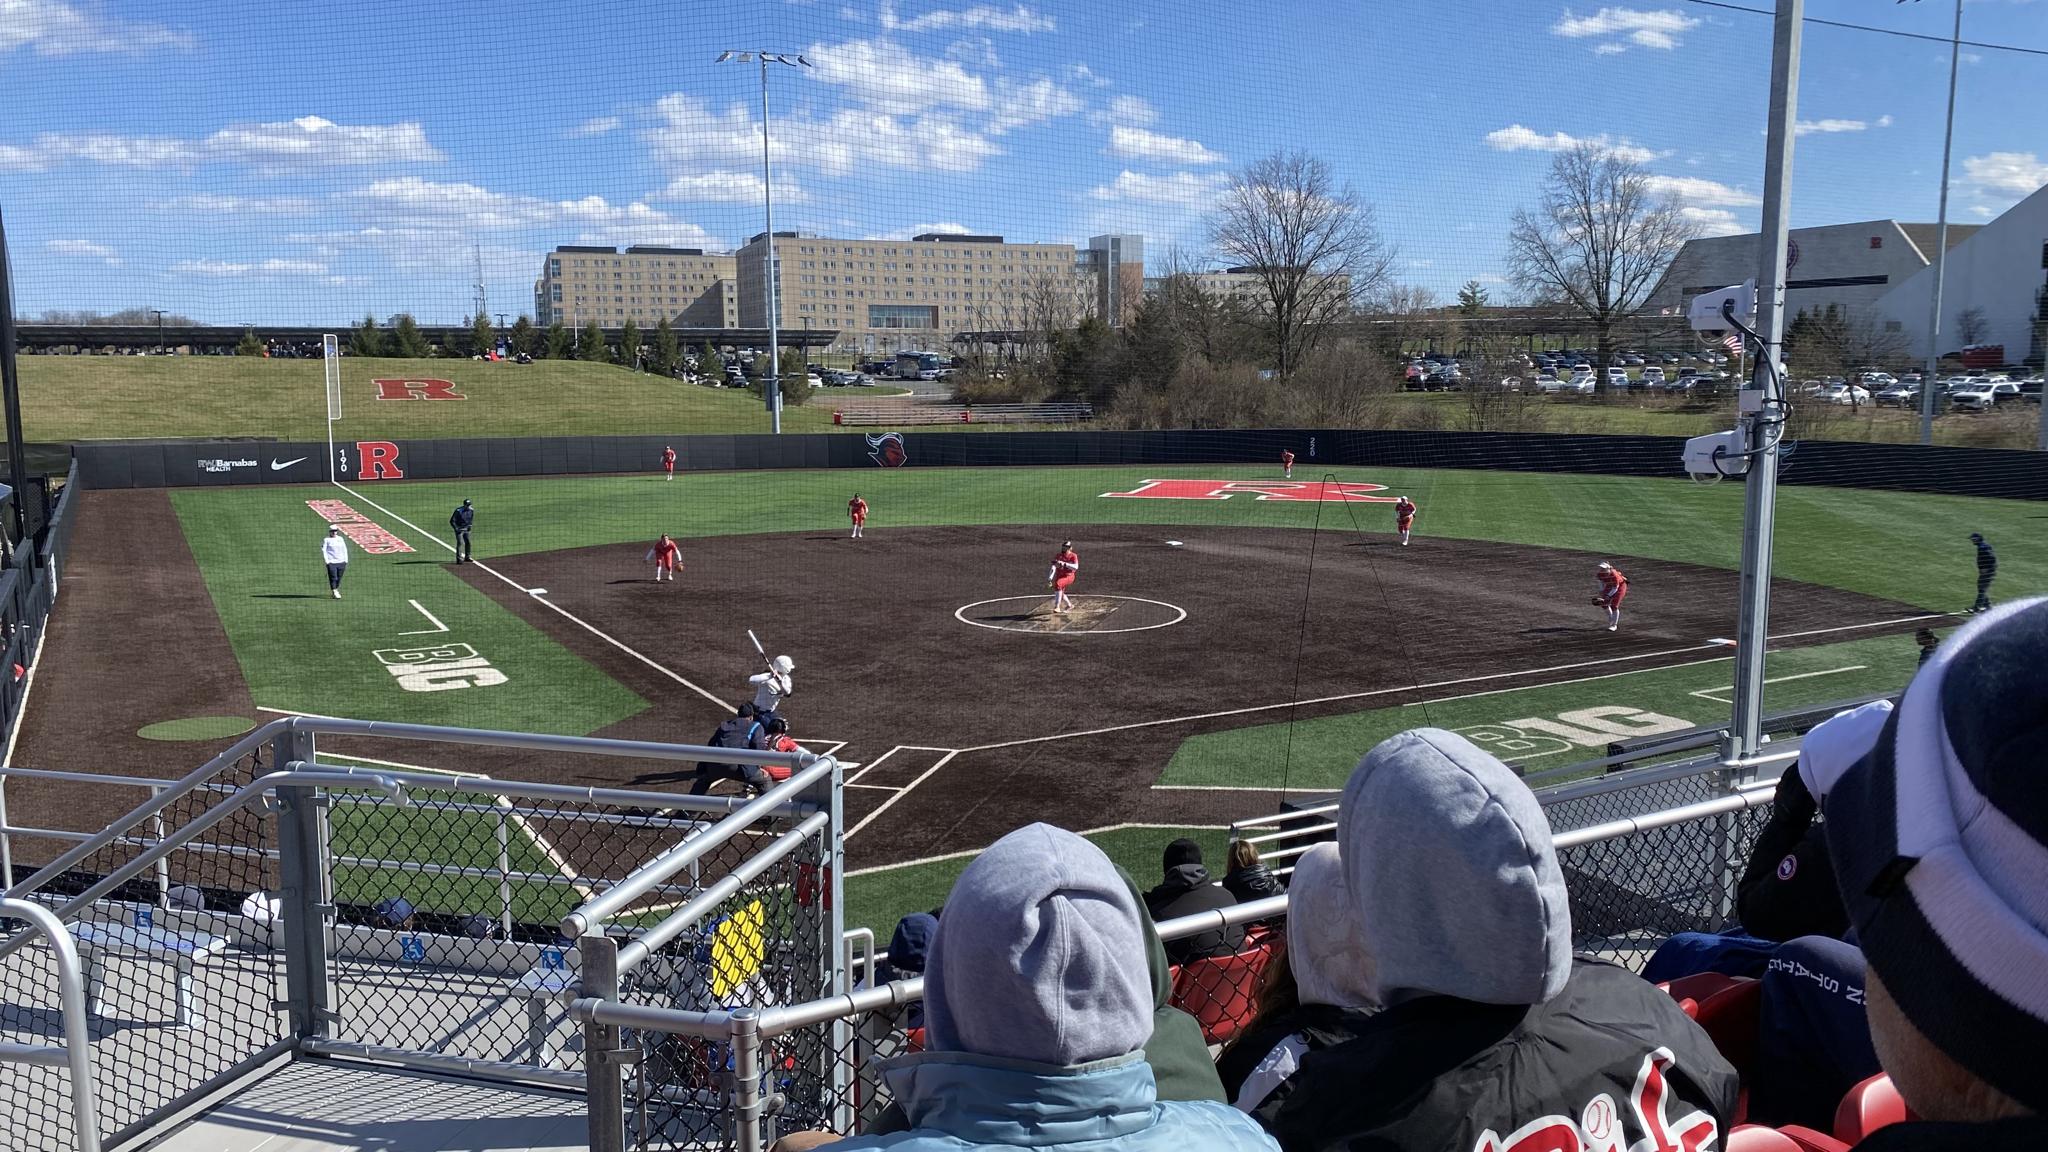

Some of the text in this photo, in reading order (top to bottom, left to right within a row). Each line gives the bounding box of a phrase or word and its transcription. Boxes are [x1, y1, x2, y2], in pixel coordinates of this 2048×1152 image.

[371, 378, 468, 400] R
[340, 448, 348, 472] 190
[356, 441, 403, 480] R
[1098, 479, 1402, 502] R
[1768, 958, 1840, 993] STATE
